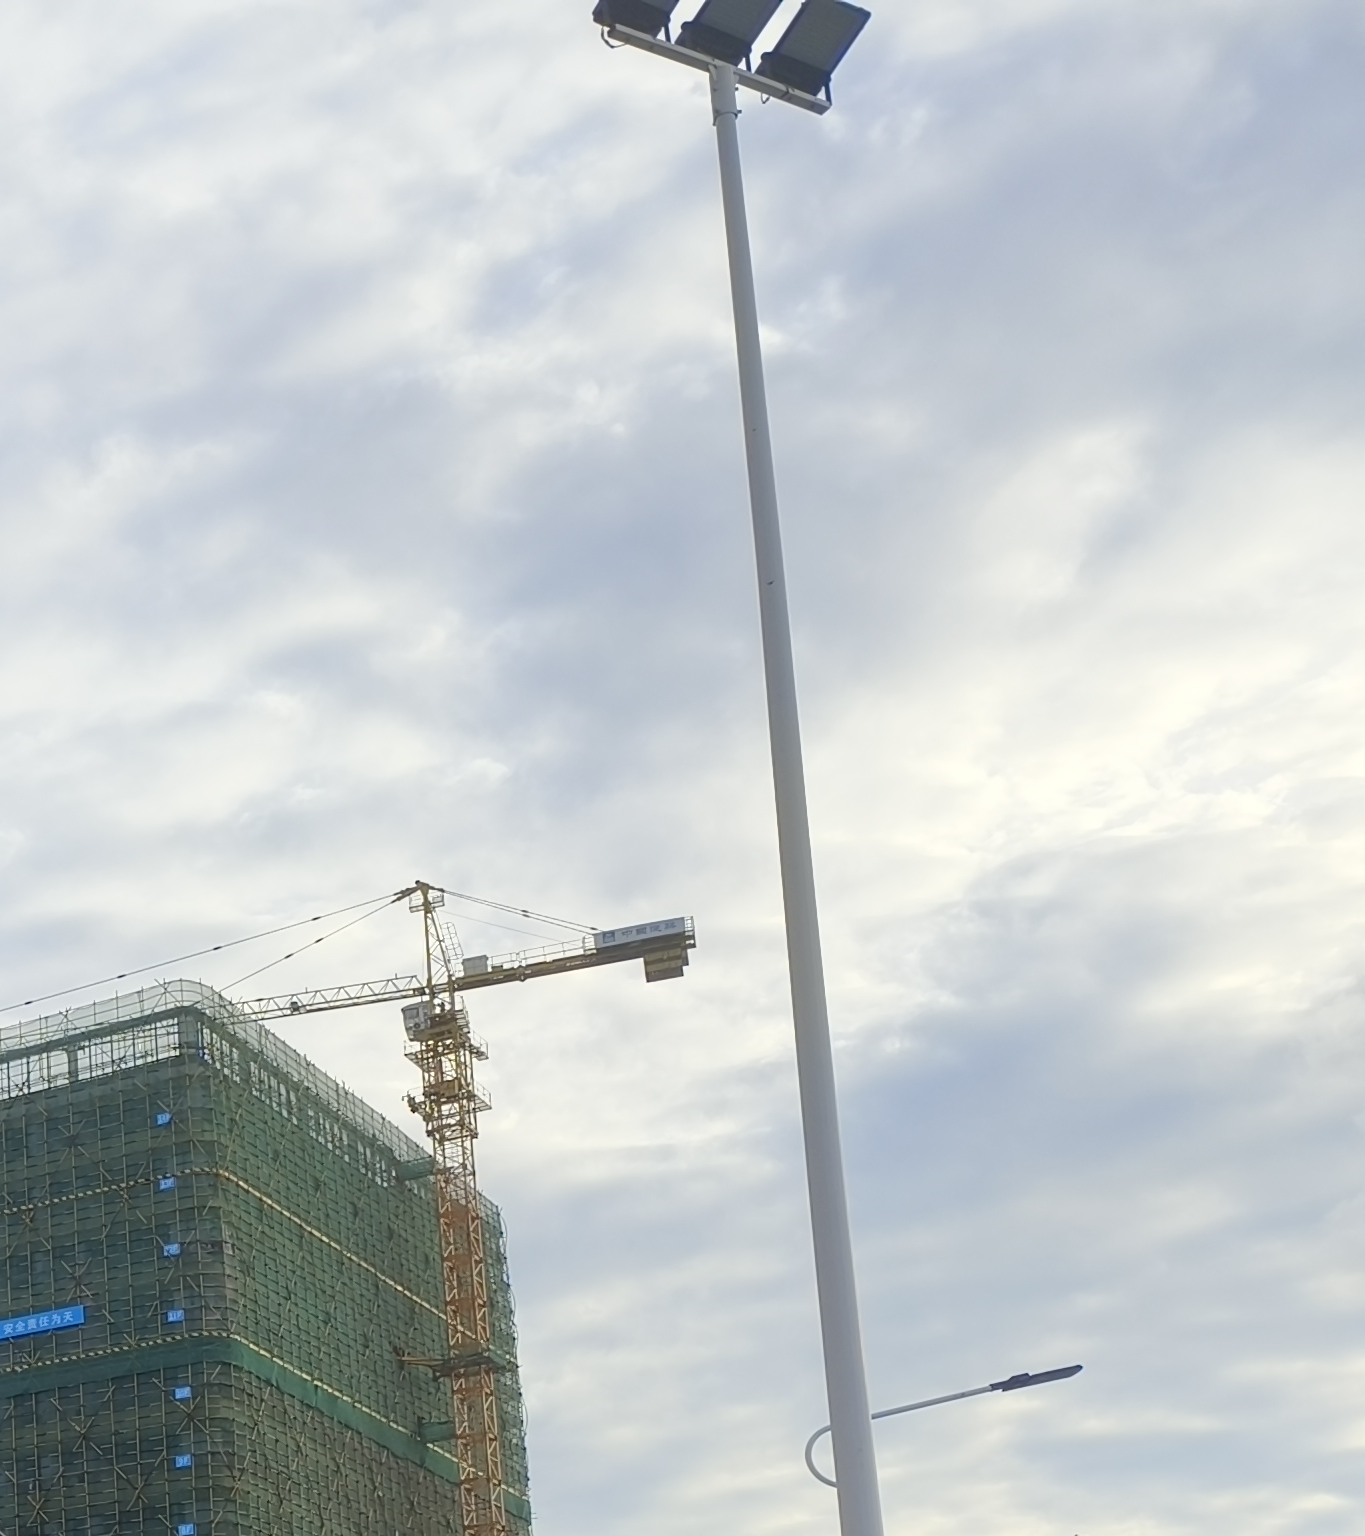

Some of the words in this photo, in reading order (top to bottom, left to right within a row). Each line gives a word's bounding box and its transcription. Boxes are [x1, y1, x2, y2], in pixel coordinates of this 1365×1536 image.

[3, 1311, 74, 1336] 安全责任为天
